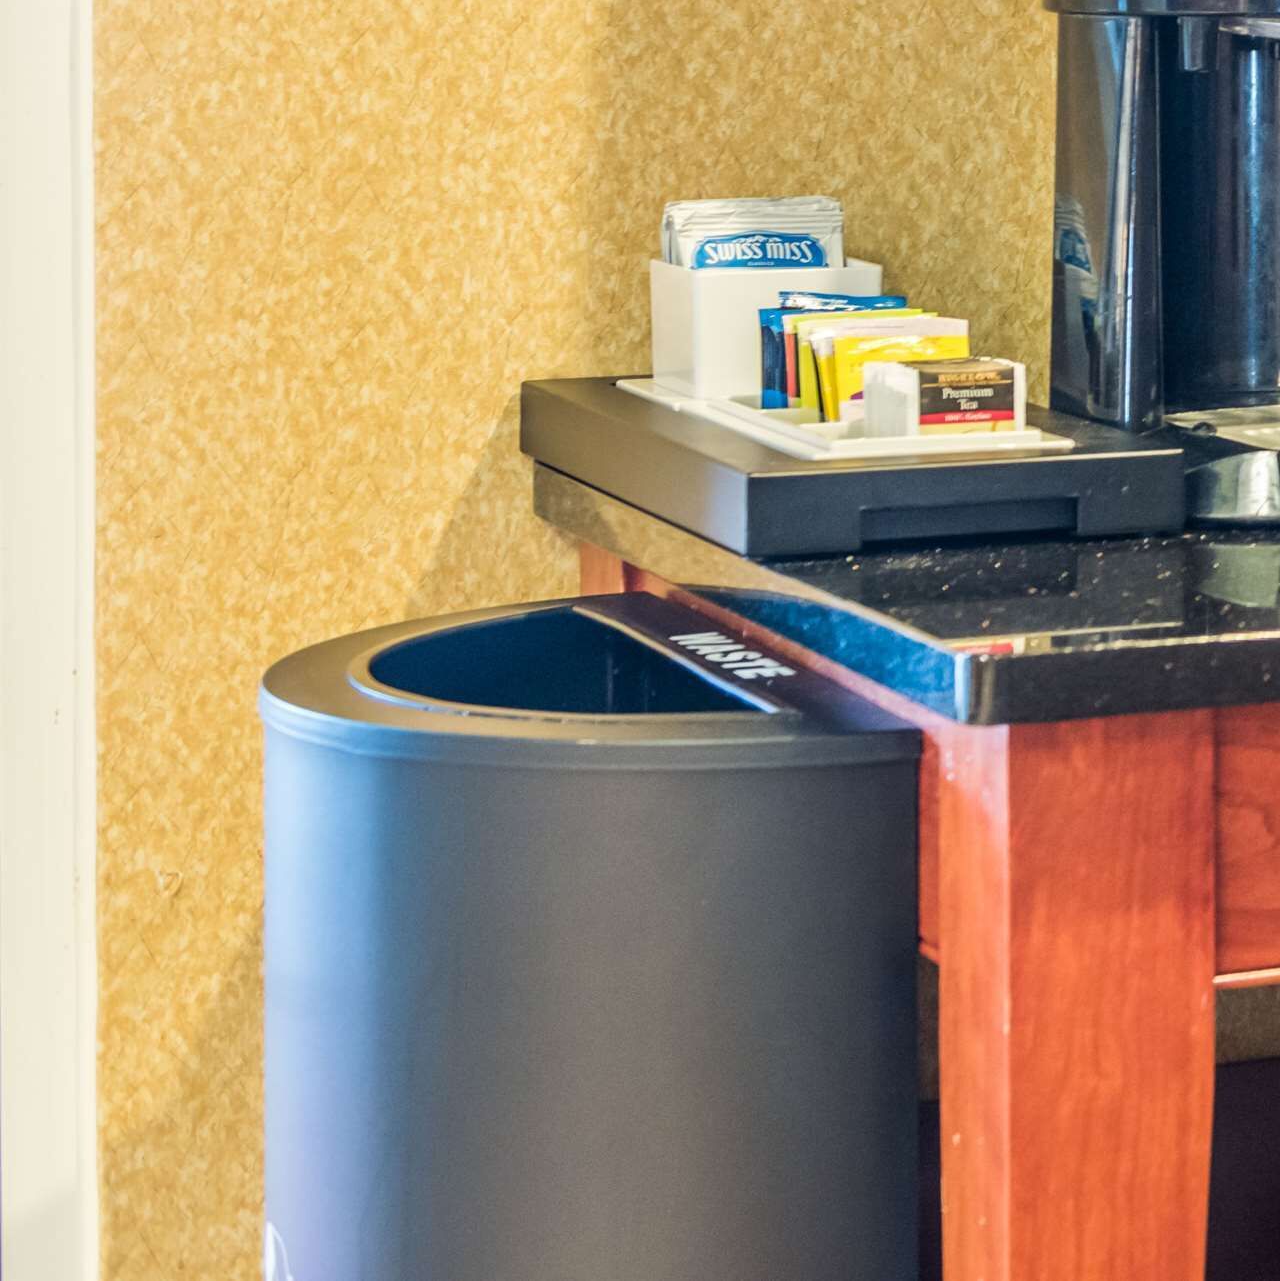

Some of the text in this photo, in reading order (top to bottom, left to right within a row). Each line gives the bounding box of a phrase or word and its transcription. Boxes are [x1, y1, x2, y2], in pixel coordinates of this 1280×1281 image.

[942, 386, 994, 400] Premium
[957, 399, 979, 411] Tea
[668, 630, 797, 681] WASTE
